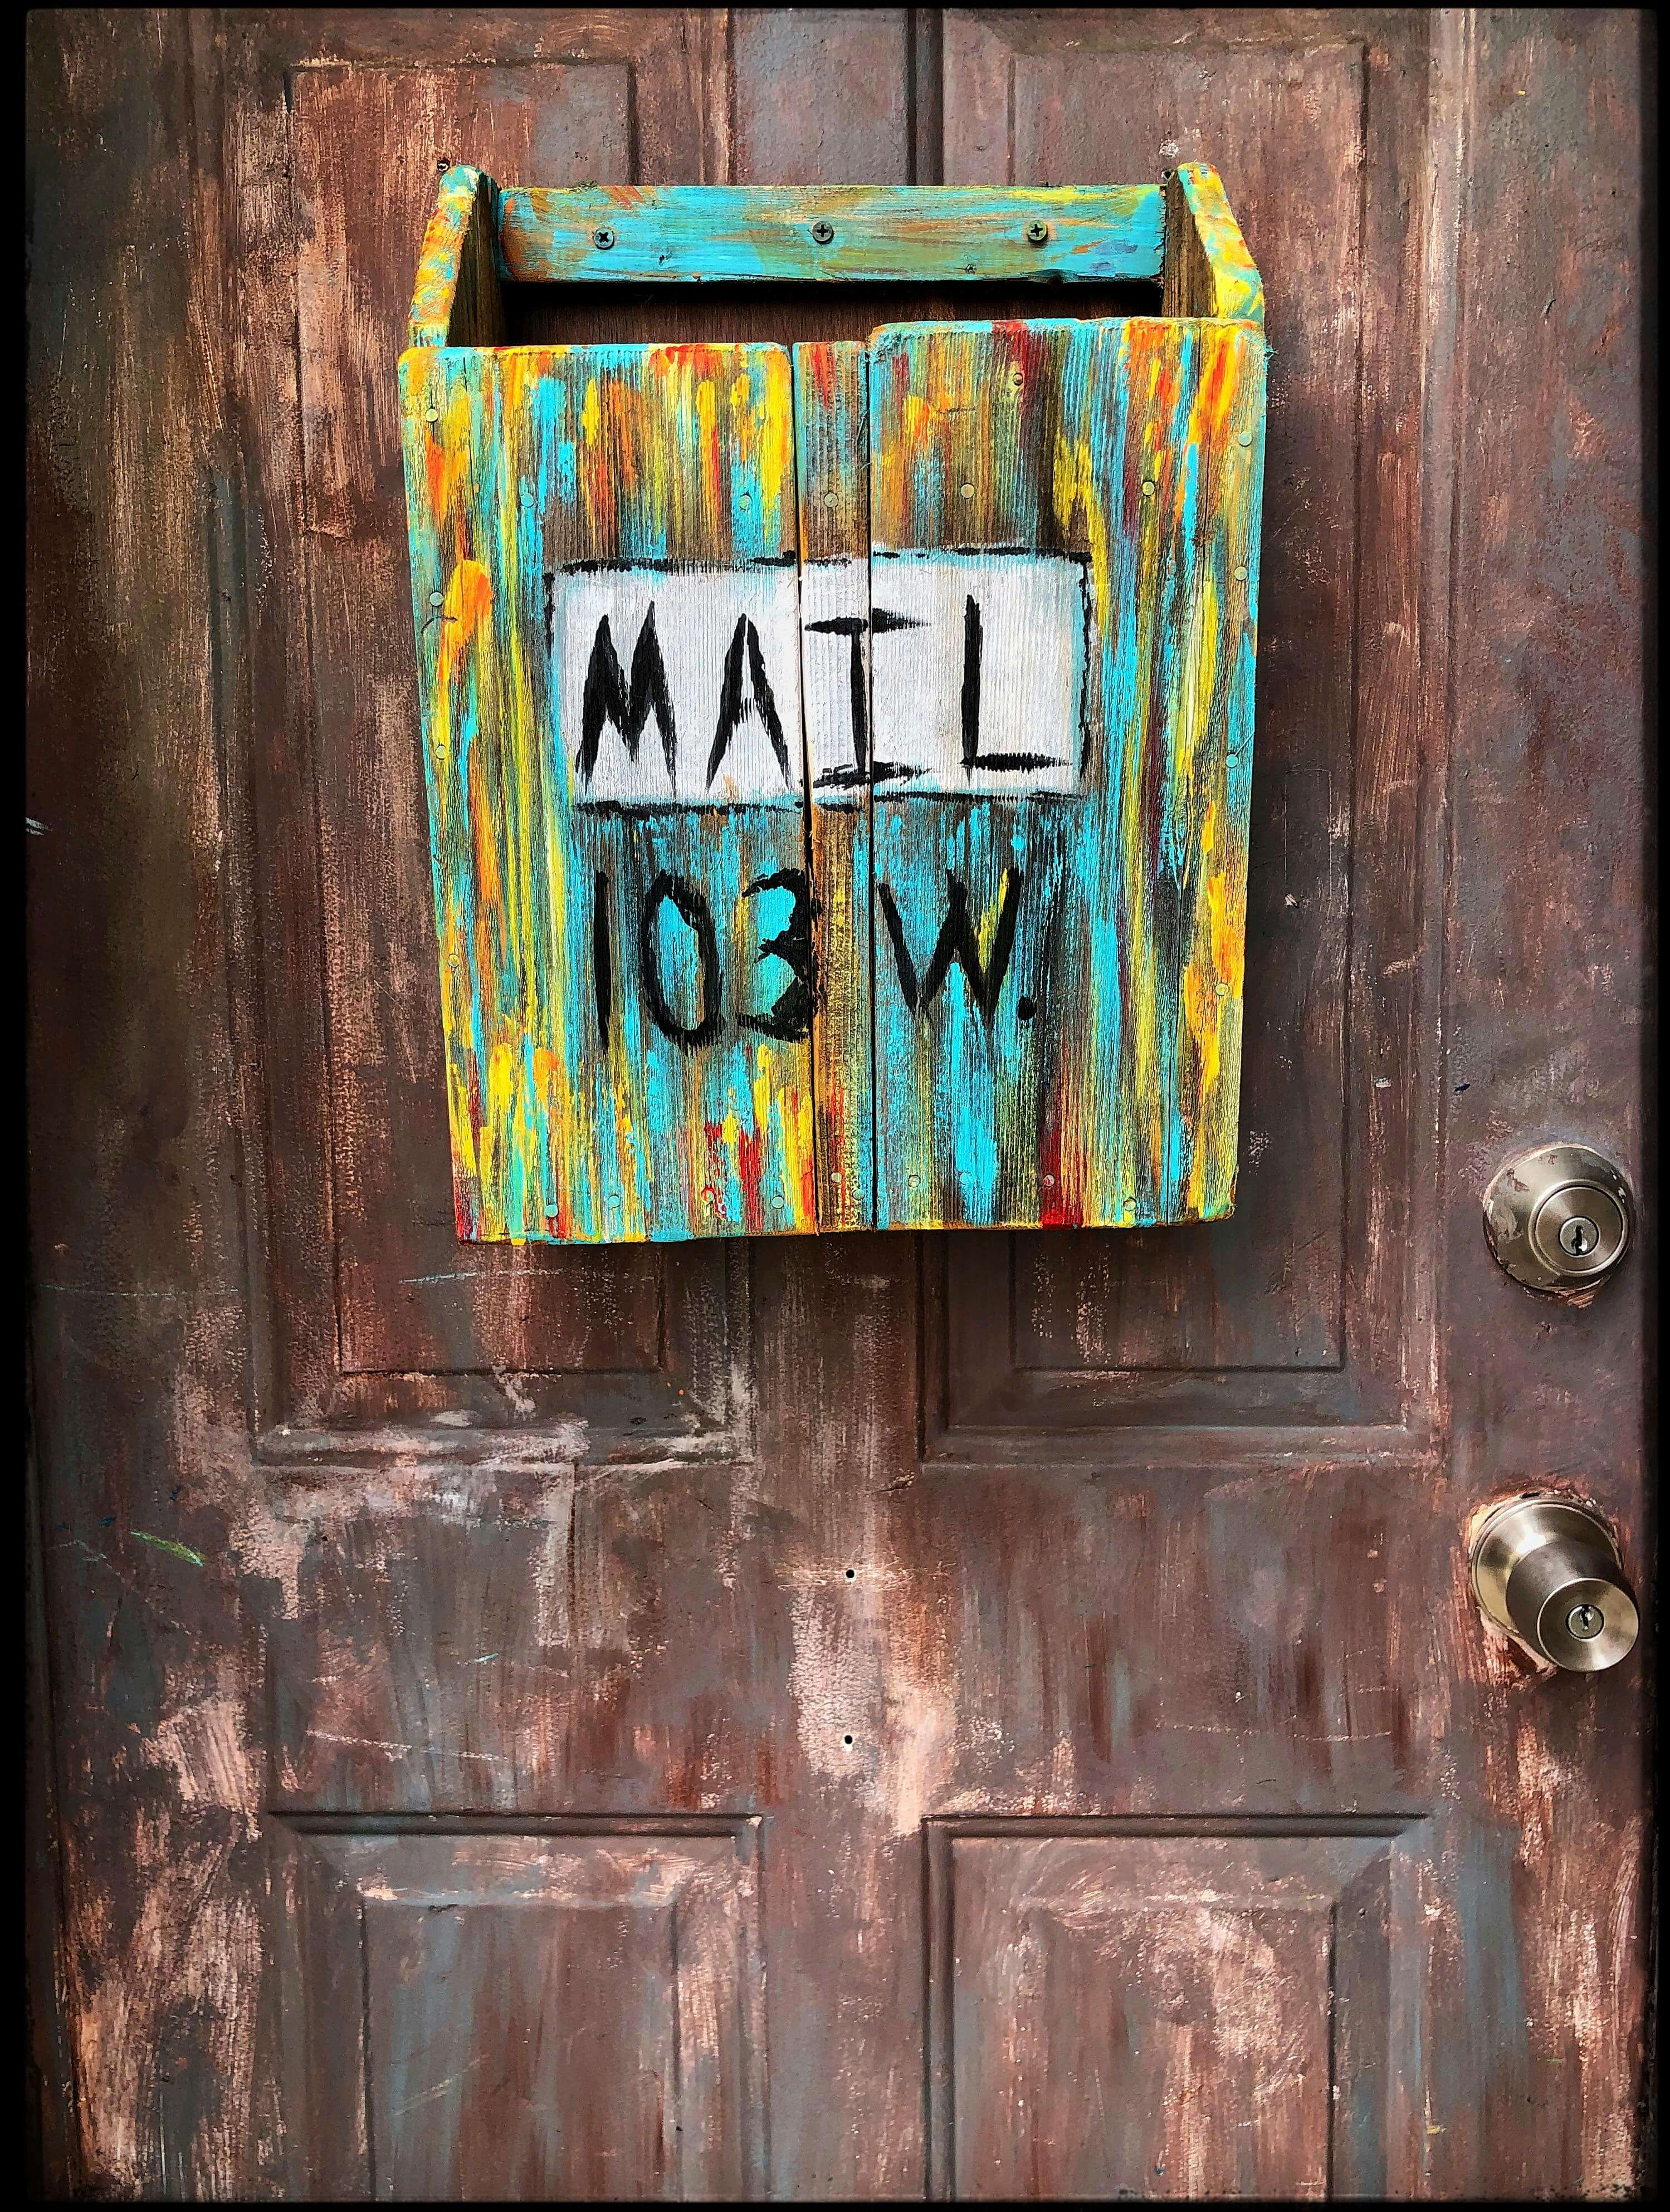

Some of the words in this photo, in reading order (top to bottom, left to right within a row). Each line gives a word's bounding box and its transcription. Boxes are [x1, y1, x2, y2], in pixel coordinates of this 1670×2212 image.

[576, 595, 1072, 791] MAIL
[593, 868, 821, 1053] 103
[878, 866, 1037, 1024] W.
